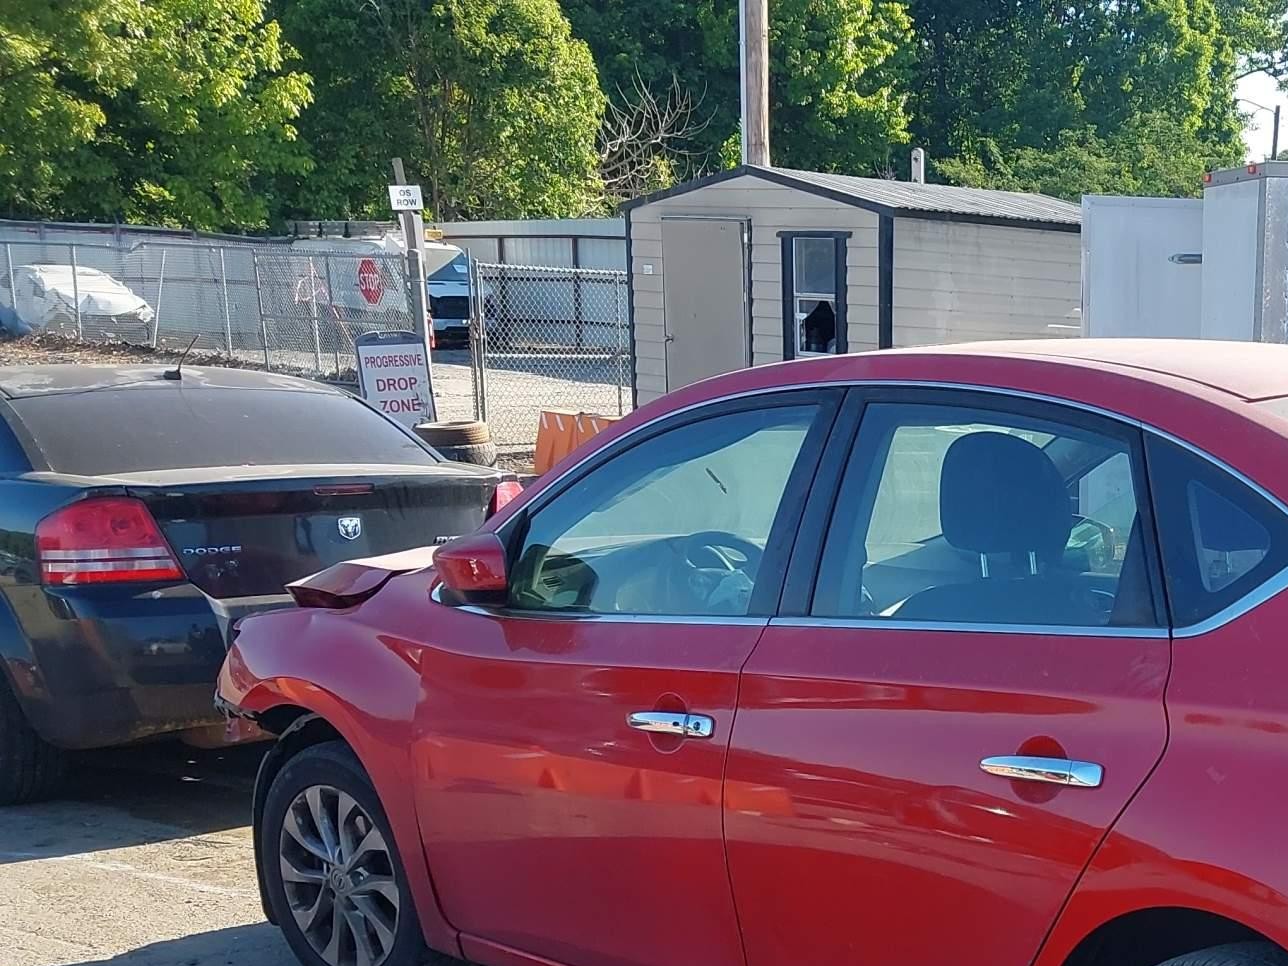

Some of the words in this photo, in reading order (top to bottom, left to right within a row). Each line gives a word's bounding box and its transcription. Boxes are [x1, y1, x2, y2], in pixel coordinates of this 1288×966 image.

[398, 189, 412, 197] OS
[396, 198, 417, 206] ROW
[360, 273, 379, 291] STOP
[364, 353, 424, 369] PROGRESSIVE
[376, 377, 418, 392] DROP
[379, 398, 422, 414] ZONE
[183, 545, 242, 555] DODGE
